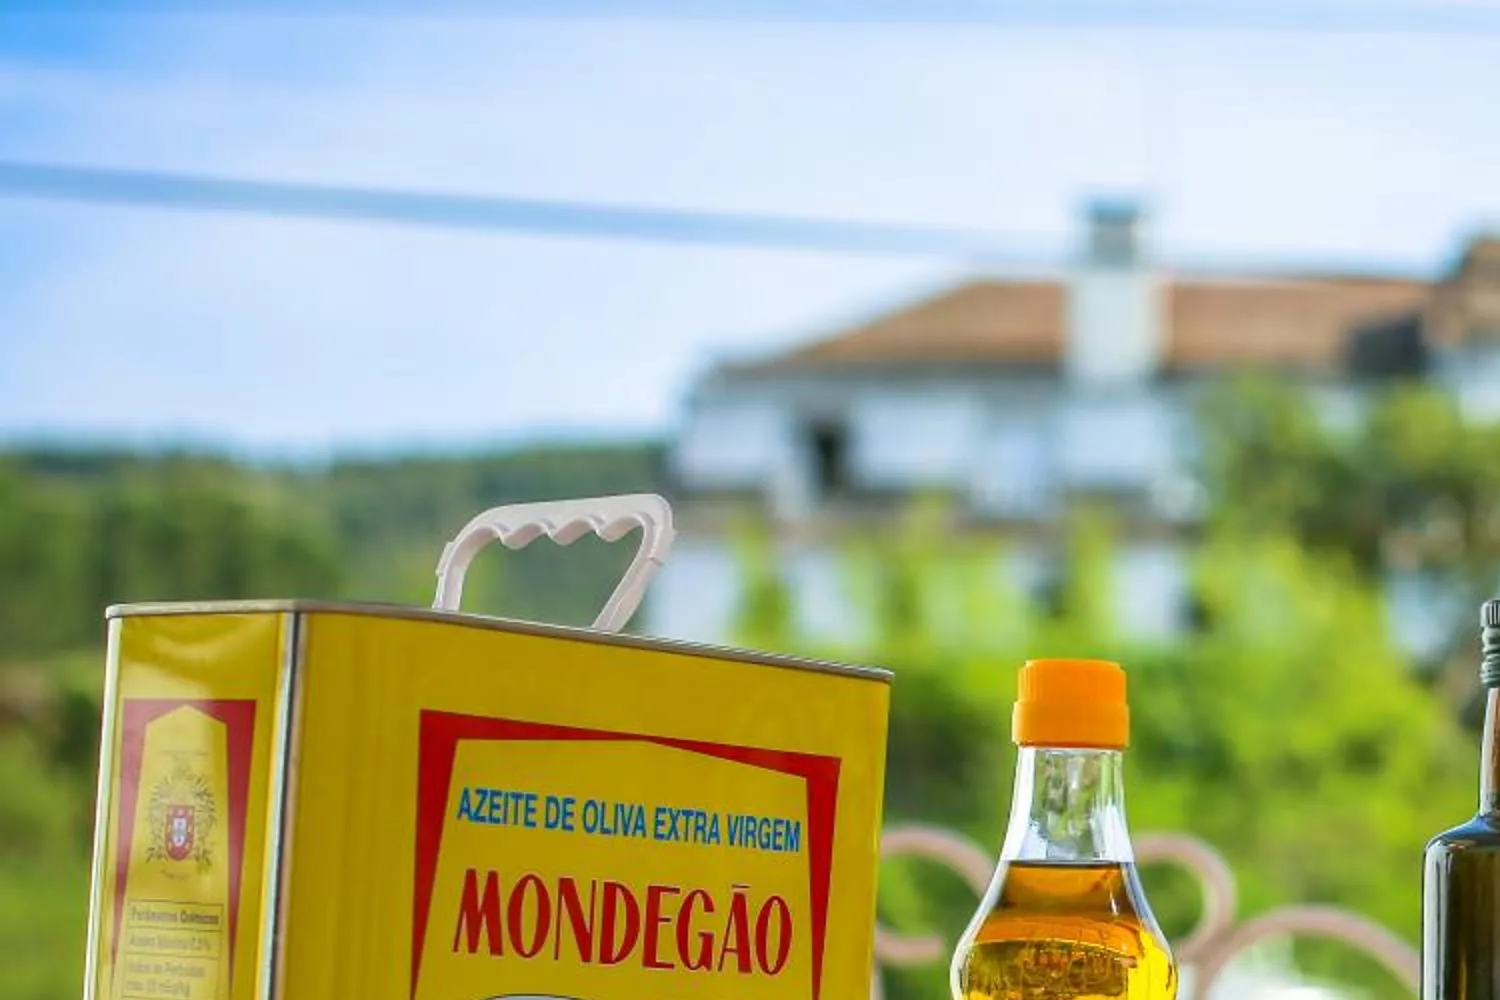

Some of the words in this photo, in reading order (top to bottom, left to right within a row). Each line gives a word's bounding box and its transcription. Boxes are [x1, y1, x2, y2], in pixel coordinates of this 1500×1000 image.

[457, 787, 536, 827] AZEITE
[544, 795, 576, 832] DE
[582, 800, 647, 838] OLIVA
[653, 807, 721, 846] EXTRA
[727, 815, 801, 853] VIRGEM
[453, 868, 793, 976] MONDEGÃO
